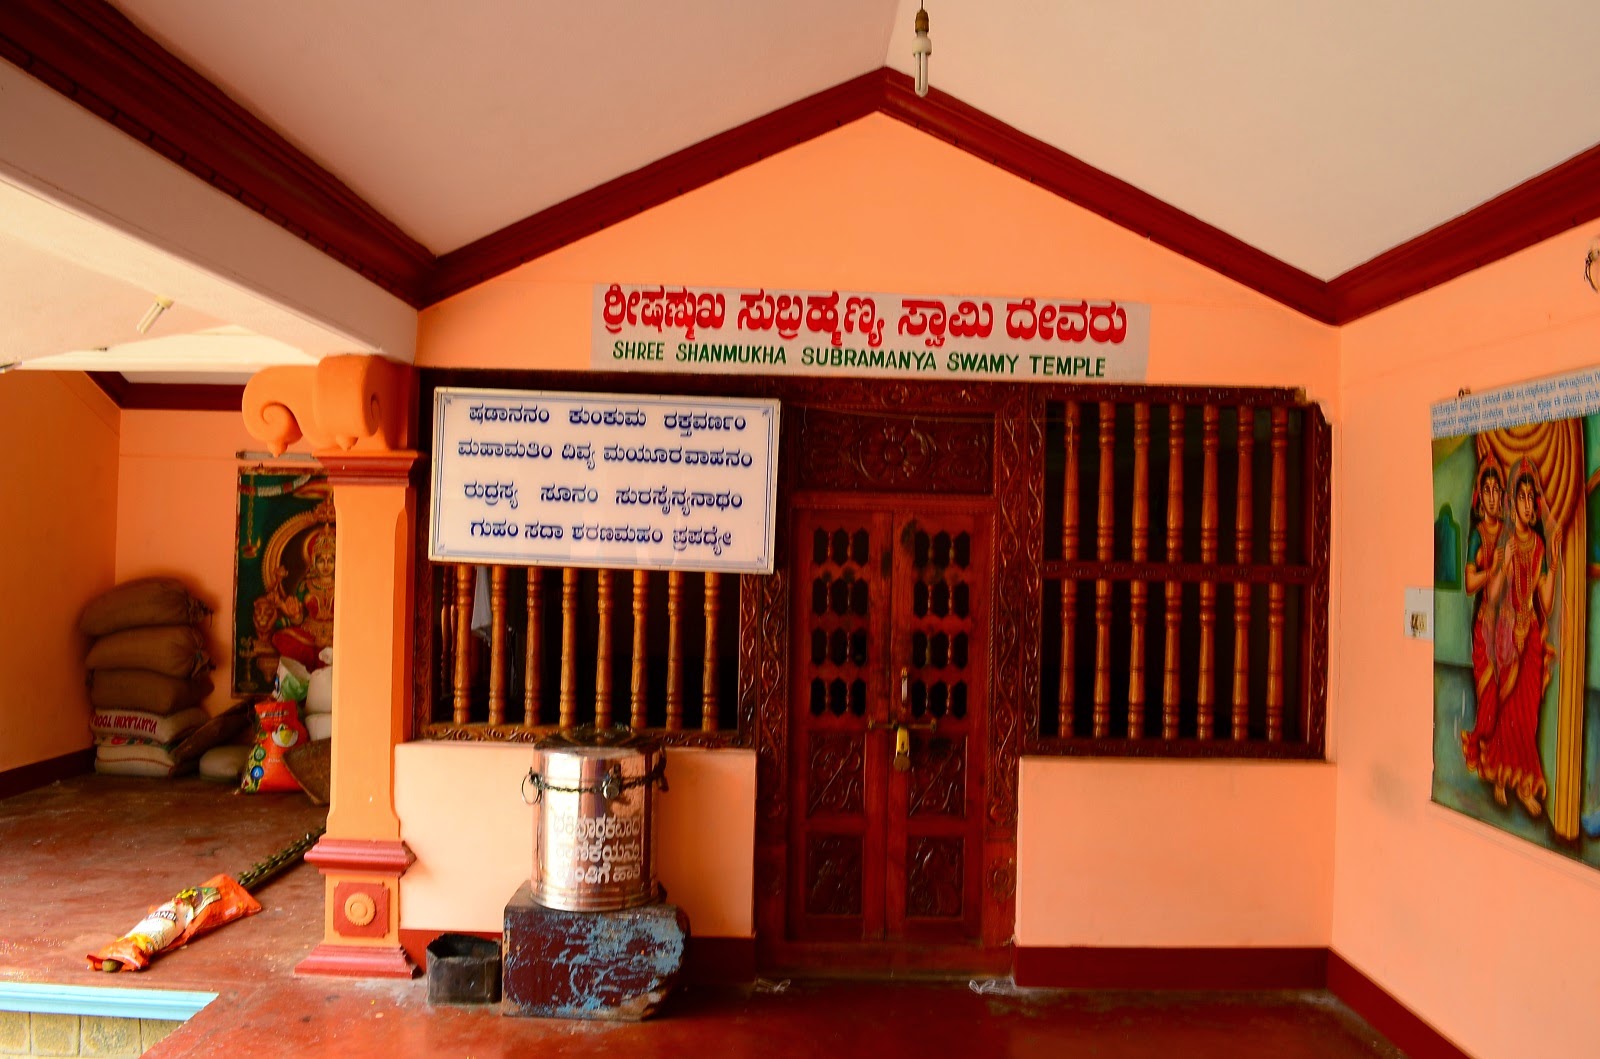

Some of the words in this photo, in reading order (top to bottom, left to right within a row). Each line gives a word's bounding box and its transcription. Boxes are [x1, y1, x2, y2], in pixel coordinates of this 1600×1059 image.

[737, 288, 885, 349] ಸುಬ್ರಹ್ಮಣ್ಯ
[897, 299, 994, 348] ಸ್ವಾಮಿ
[1005, 297, 1127, 345] ದೇವರು
[612, 341, 665, 360] SHREE
[675, 343, 787, 365] SHANMUKHA
[801, 347, 937, 371] SUBRAMANYA
[946, 352, 1020, 374] SWAMY
[1029, 355, 1106, 377] TEMPLE
[469, 402, 550, 425] ಷಡಾನನಂ
[568, 406, 647, 428] ಕುಂಕುಮ
[458, 438, 553, 460] ಮಹಾಮತಿಂ
[561, 442, 596, 471] ದಿವ್ಯ
[463, 480, 519, 510] ರುದ್ರಸ್ಯ
[524, 521, 564, 540] ಸದಾ
[113, 716, 158, 735] VIJAYLAXMI
